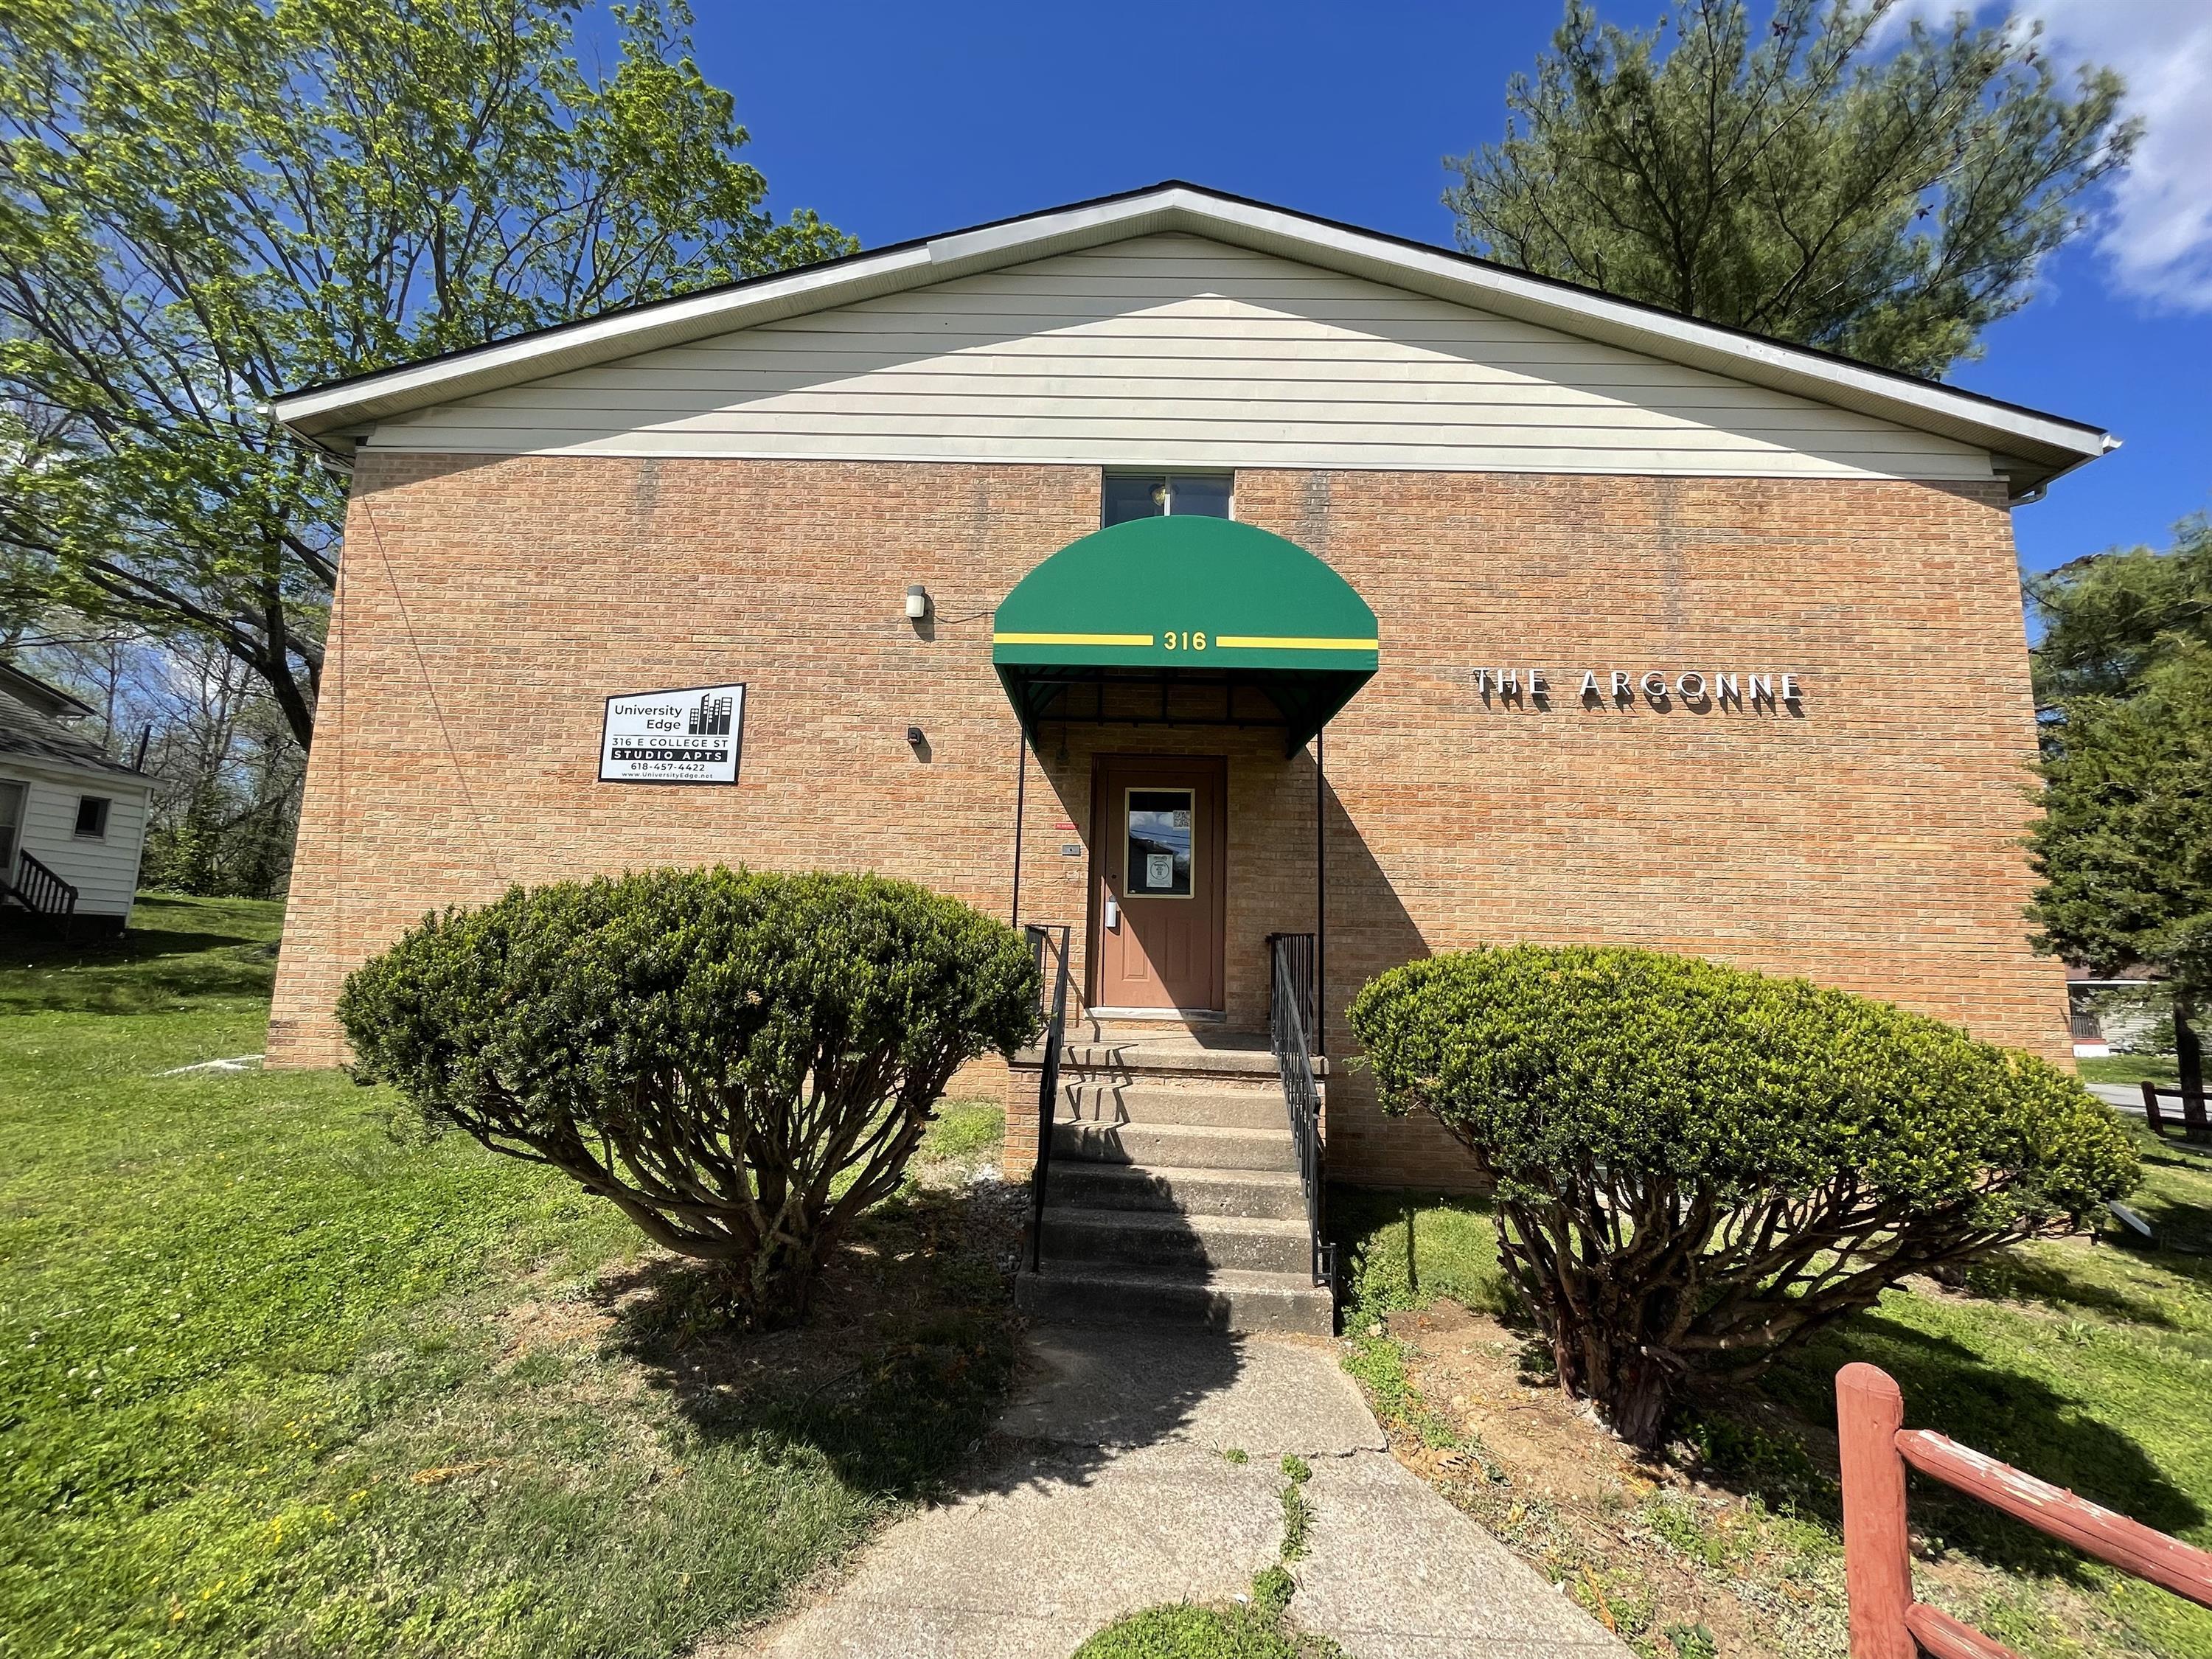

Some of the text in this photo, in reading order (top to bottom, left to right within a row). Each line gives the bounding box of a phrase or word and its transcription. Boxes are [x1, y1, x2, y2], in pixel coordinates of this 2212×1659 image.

[1164, 631, 1206, 650] 316
[1473, 667, 1804, 700] THE ARGONNE
[615, 705, 683, 717] University
[647, 720, 681, 731] Edge
[612, 738, 728, 748] 316 E COLLEGE ST
[613, 750, 722, 761] STUDIO APTS
[630, 762, 706, 771] 618-457-4422
